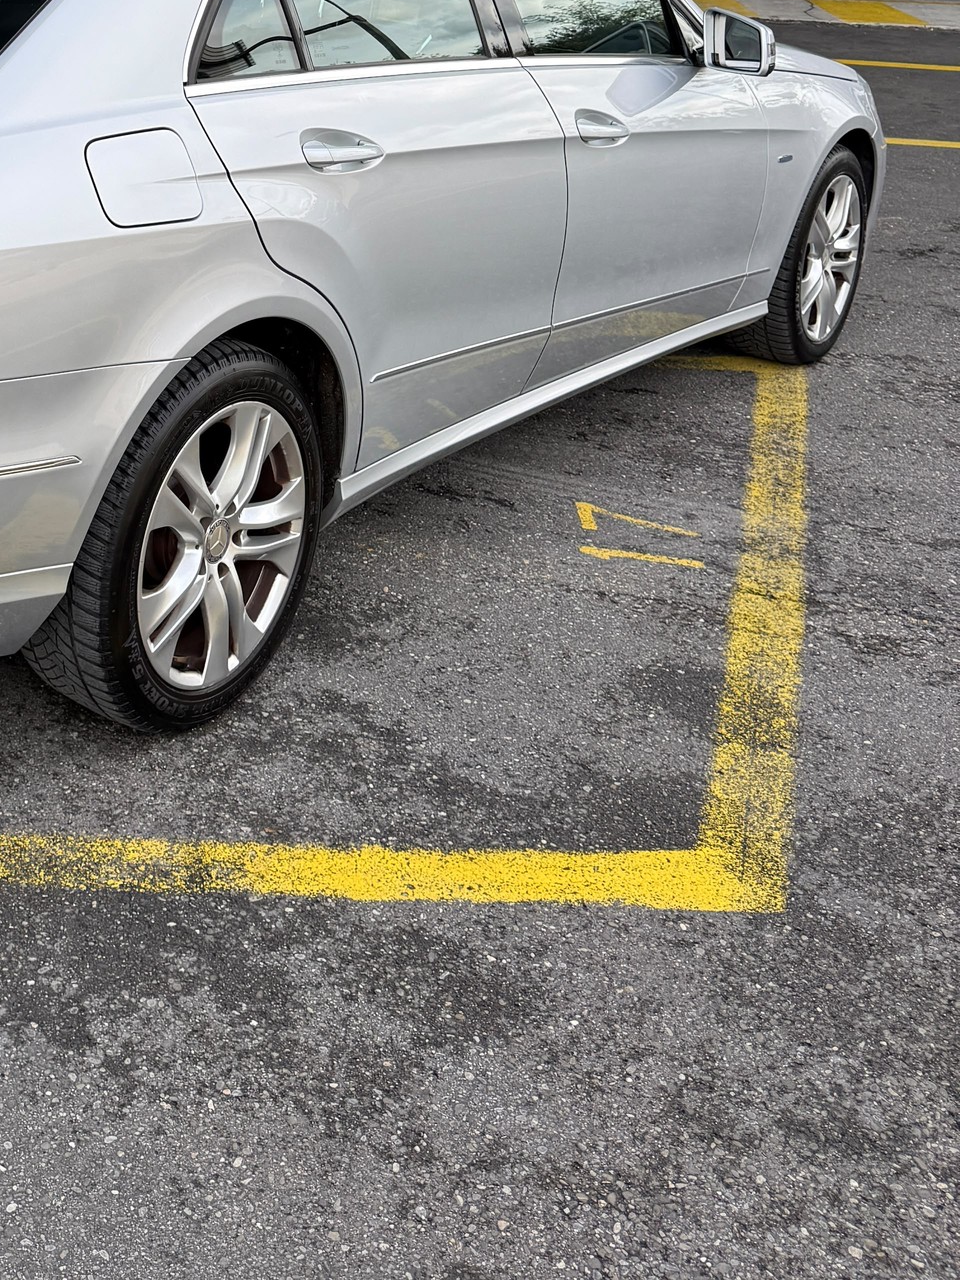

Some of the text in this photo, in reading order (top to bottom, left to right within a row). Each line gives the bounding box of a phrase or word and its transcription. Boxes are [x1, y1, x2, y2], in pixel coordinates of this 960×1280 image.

[237, 375, 304, 413] DUNLOP
[131, 663, 190, 718] SPORT 5
